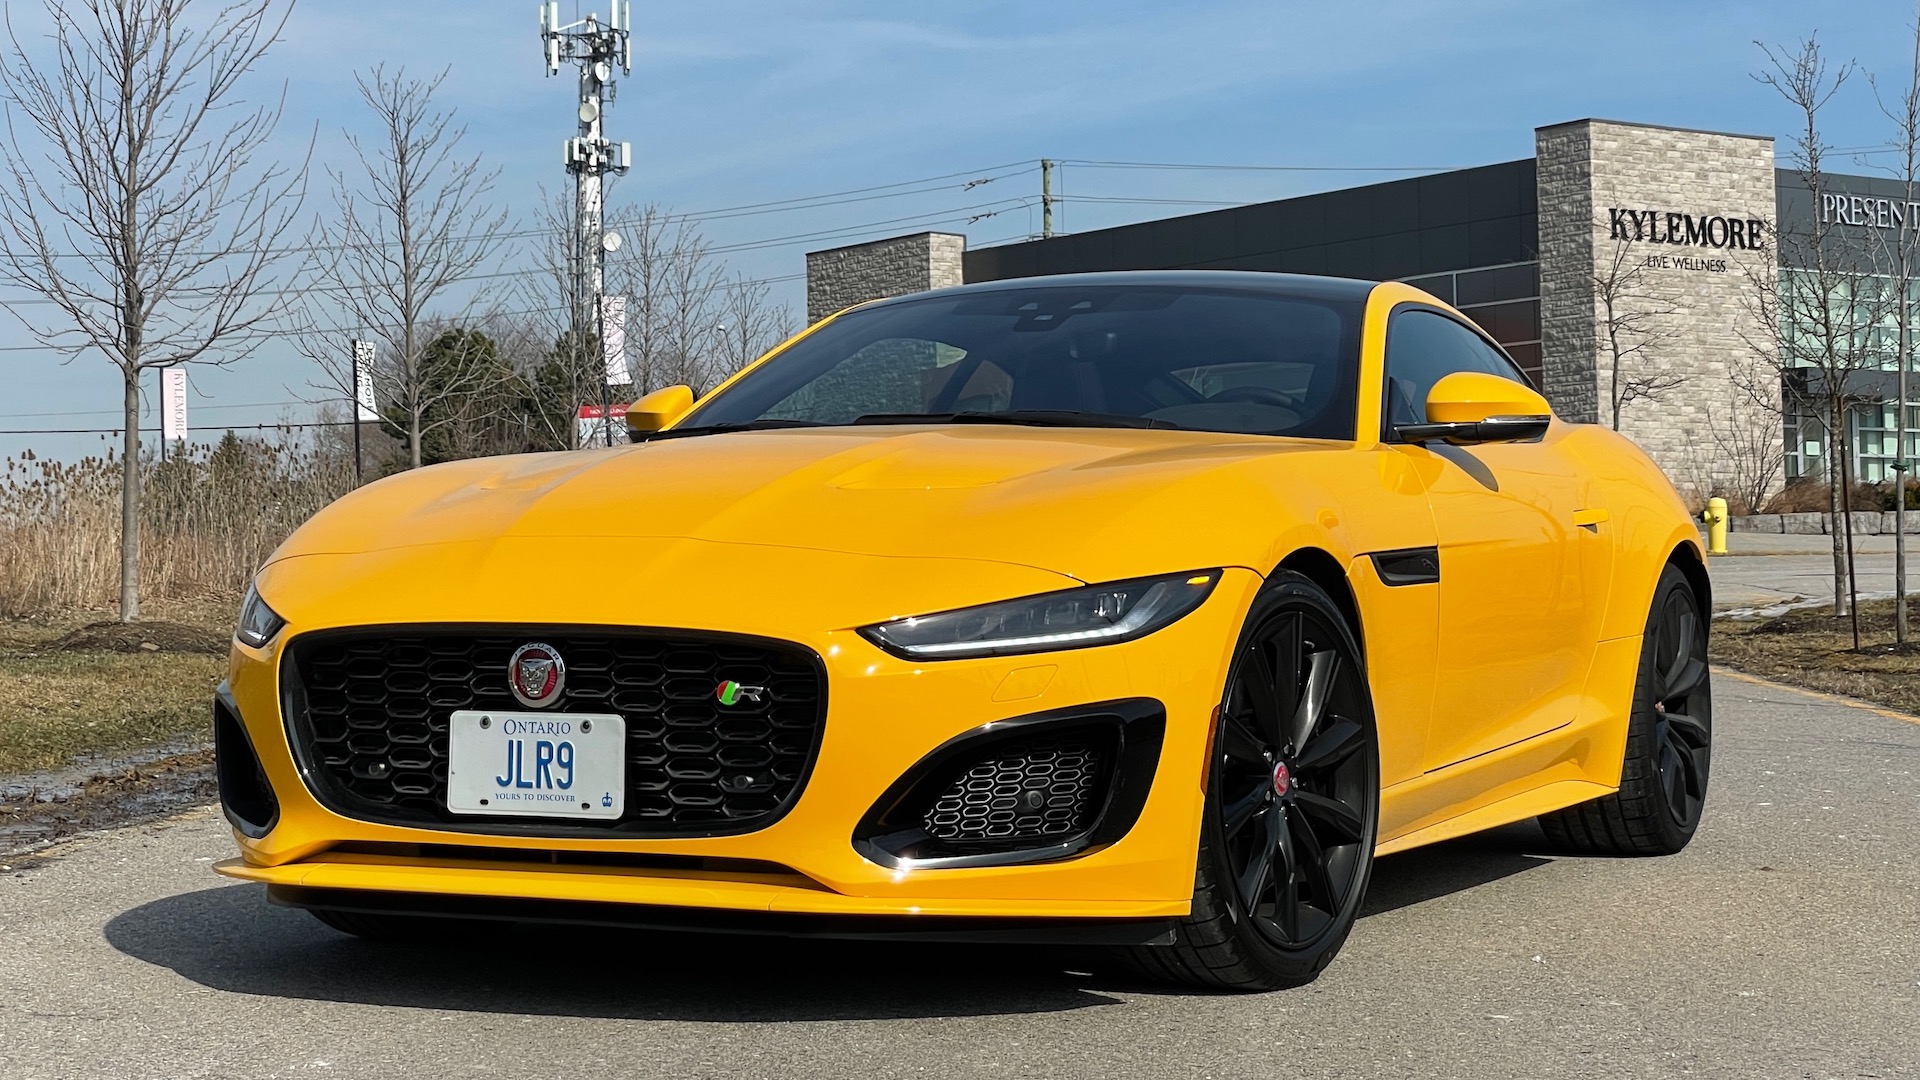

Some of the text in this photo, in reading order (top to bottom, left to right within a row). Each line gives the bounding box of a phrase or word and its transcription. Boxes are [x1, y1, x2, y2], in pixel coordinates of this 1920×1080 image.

[1609, 208, 1764, 250] KYLEMORE
[174, 373, 185, 435] KYLEMORE
[513, 641, 560, 661] JAGUAR
[496, 739, 574, 790] JLR9
[495, 792, 576, 803] YOURS TO DISCOVER
